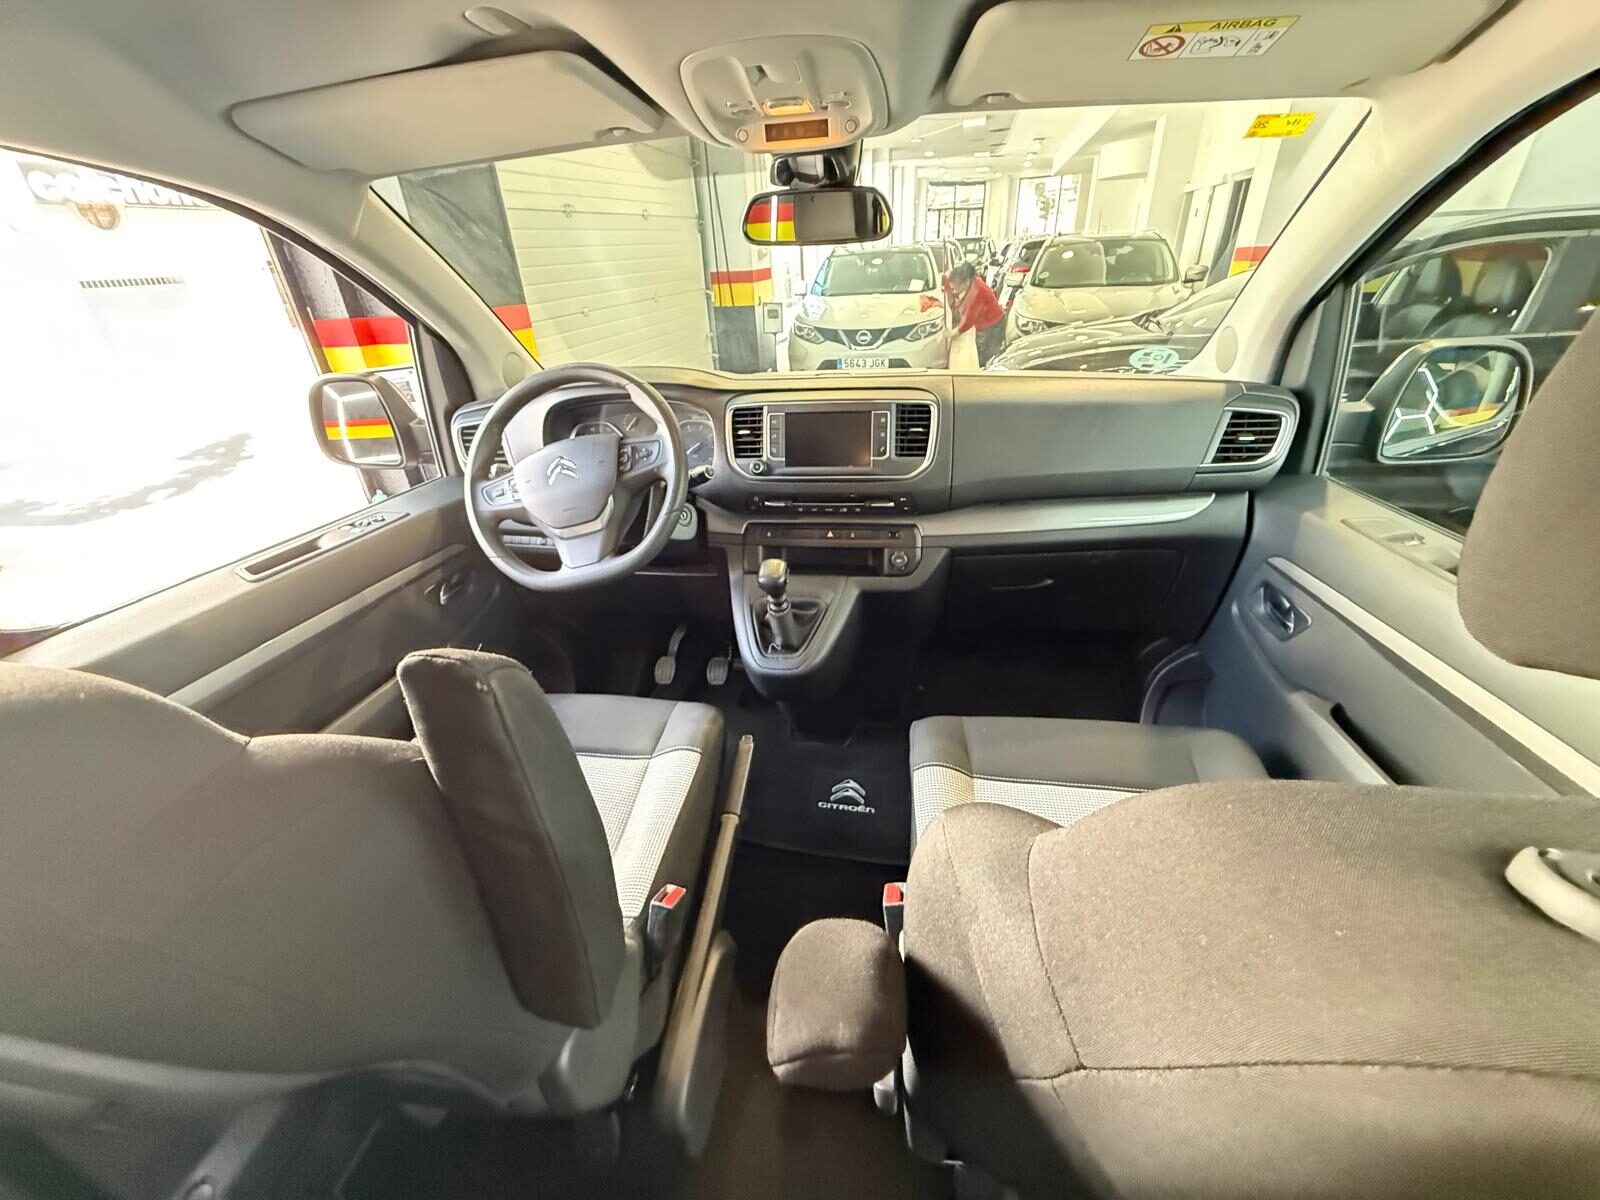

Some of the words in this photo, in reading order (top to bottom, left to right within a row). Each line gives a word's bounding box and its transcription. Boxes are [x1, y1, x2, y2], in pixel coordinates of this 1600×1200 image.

[1209, 18, 1278, 31] AIRBAG
[844, 358, 867, 368] 5643
[869, 358, 886, 368] JGK
